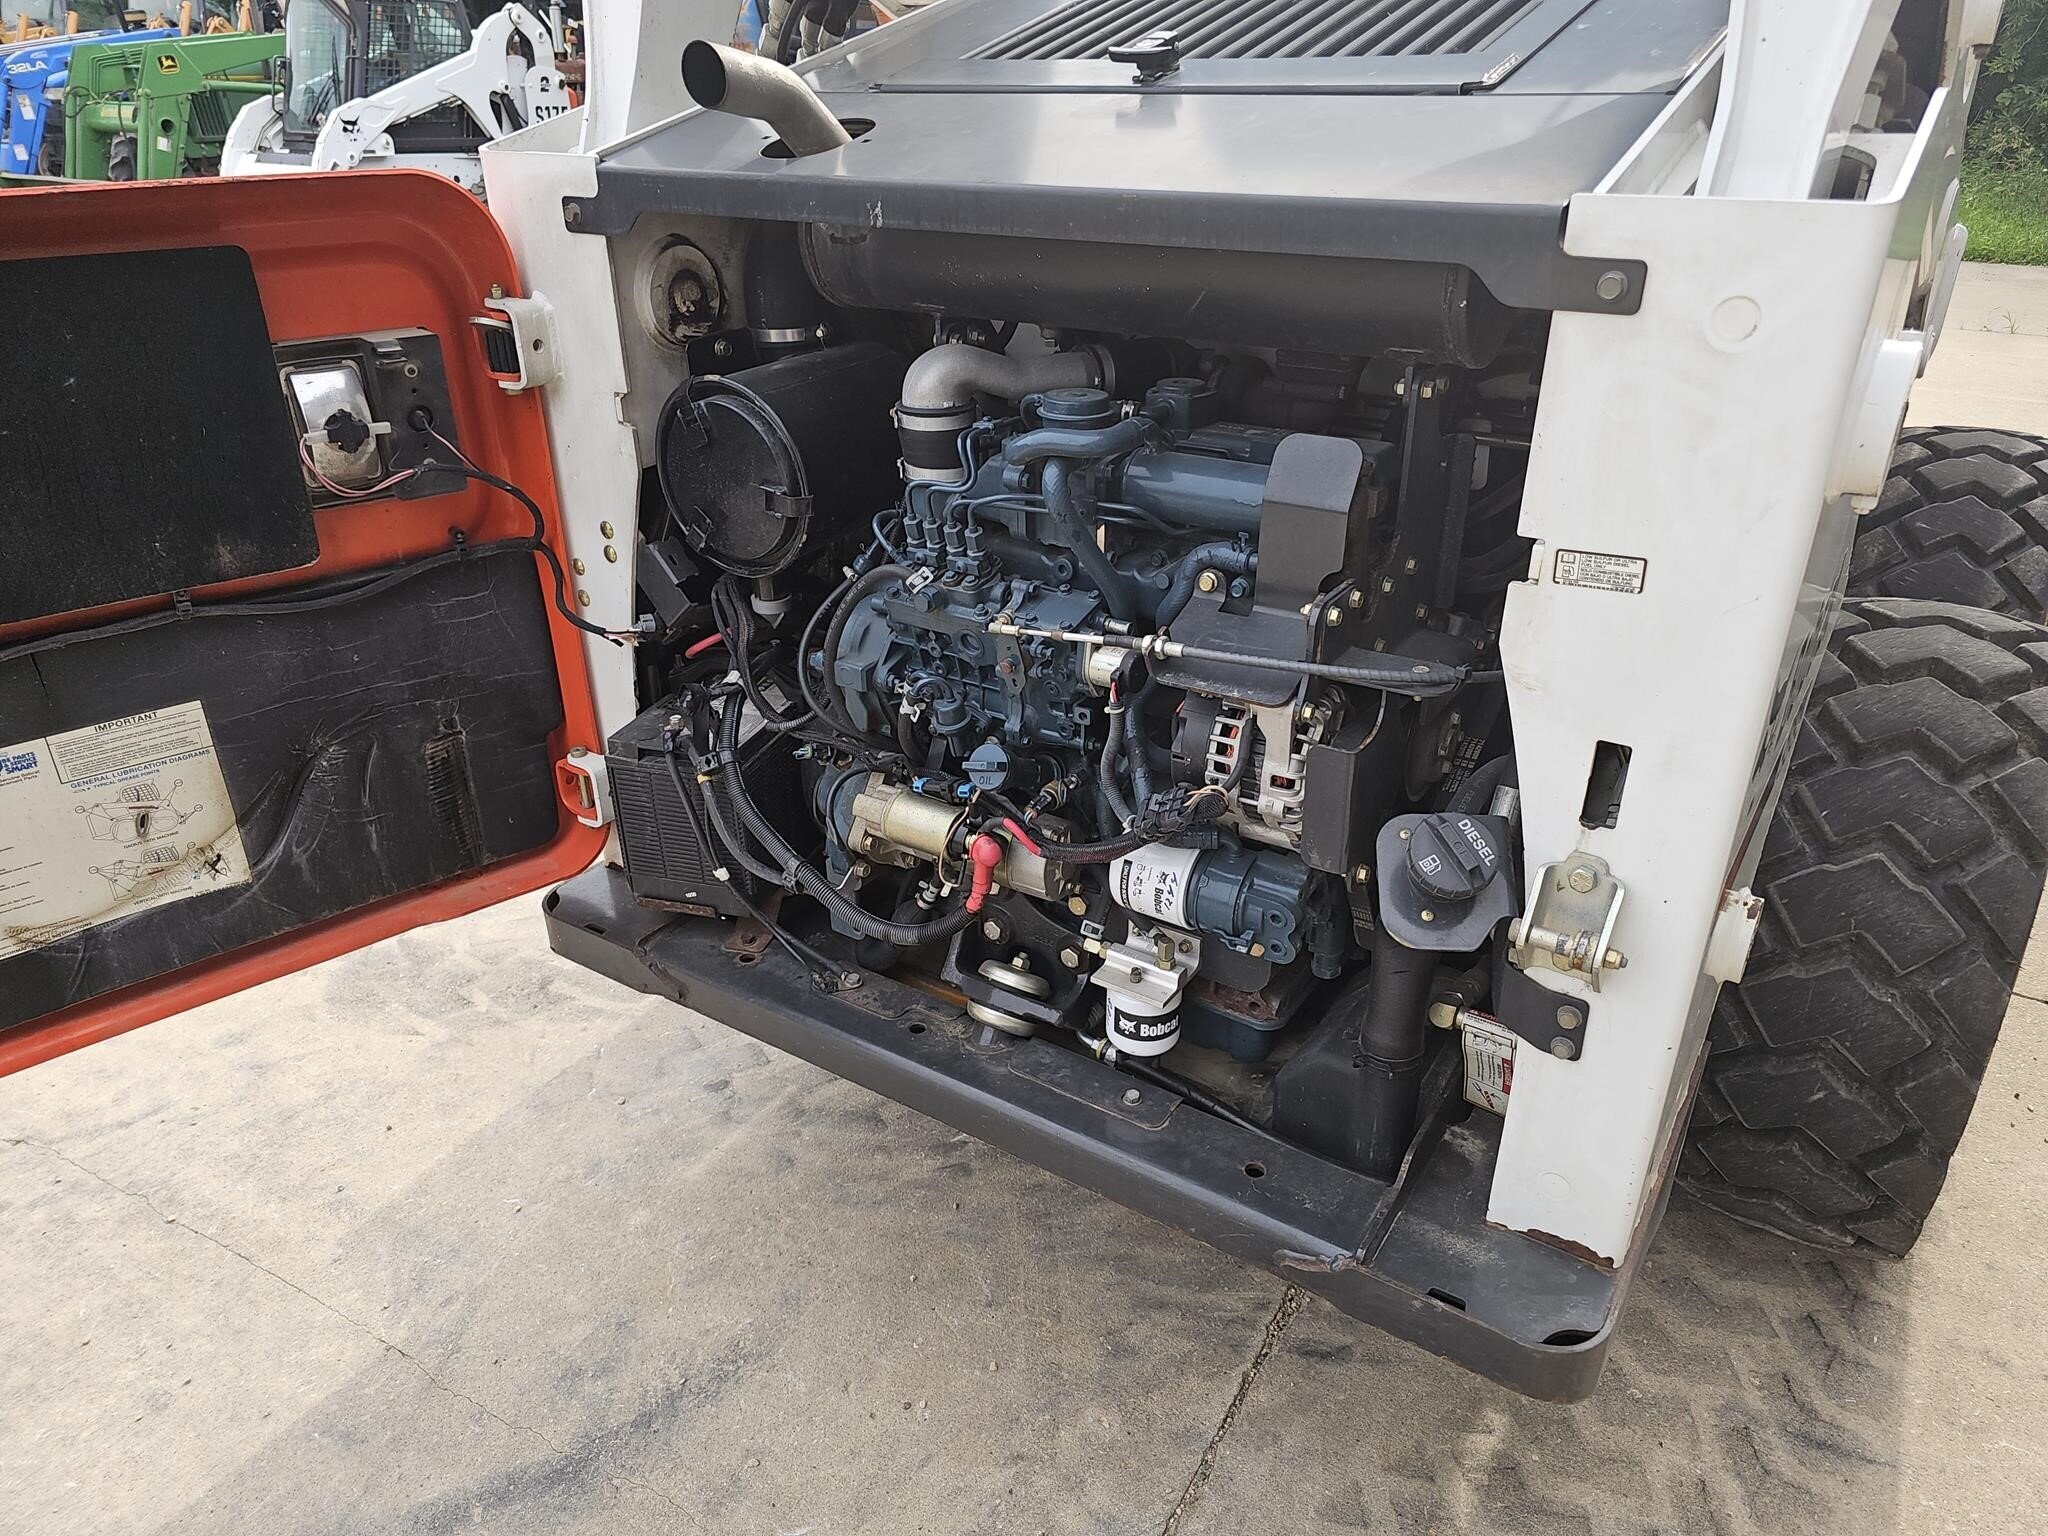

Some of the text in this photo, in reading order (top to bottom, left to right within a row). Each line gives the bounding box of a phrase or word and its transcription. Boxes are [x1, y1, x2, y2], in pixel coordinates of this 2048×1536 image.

[6, 60, 48, 74] 32LA
[94, 712, 158, 732] IMPORTANT
[12, 752, 35, 761] PARTS
[5, 761, 38, 774] SMART
[70, 749, 211, 789] GENERAL LUBRICATION DIAGRAMS
[978, 775, 993, 786] OIL
[1458, 818, 1497, 867] DIESEL
